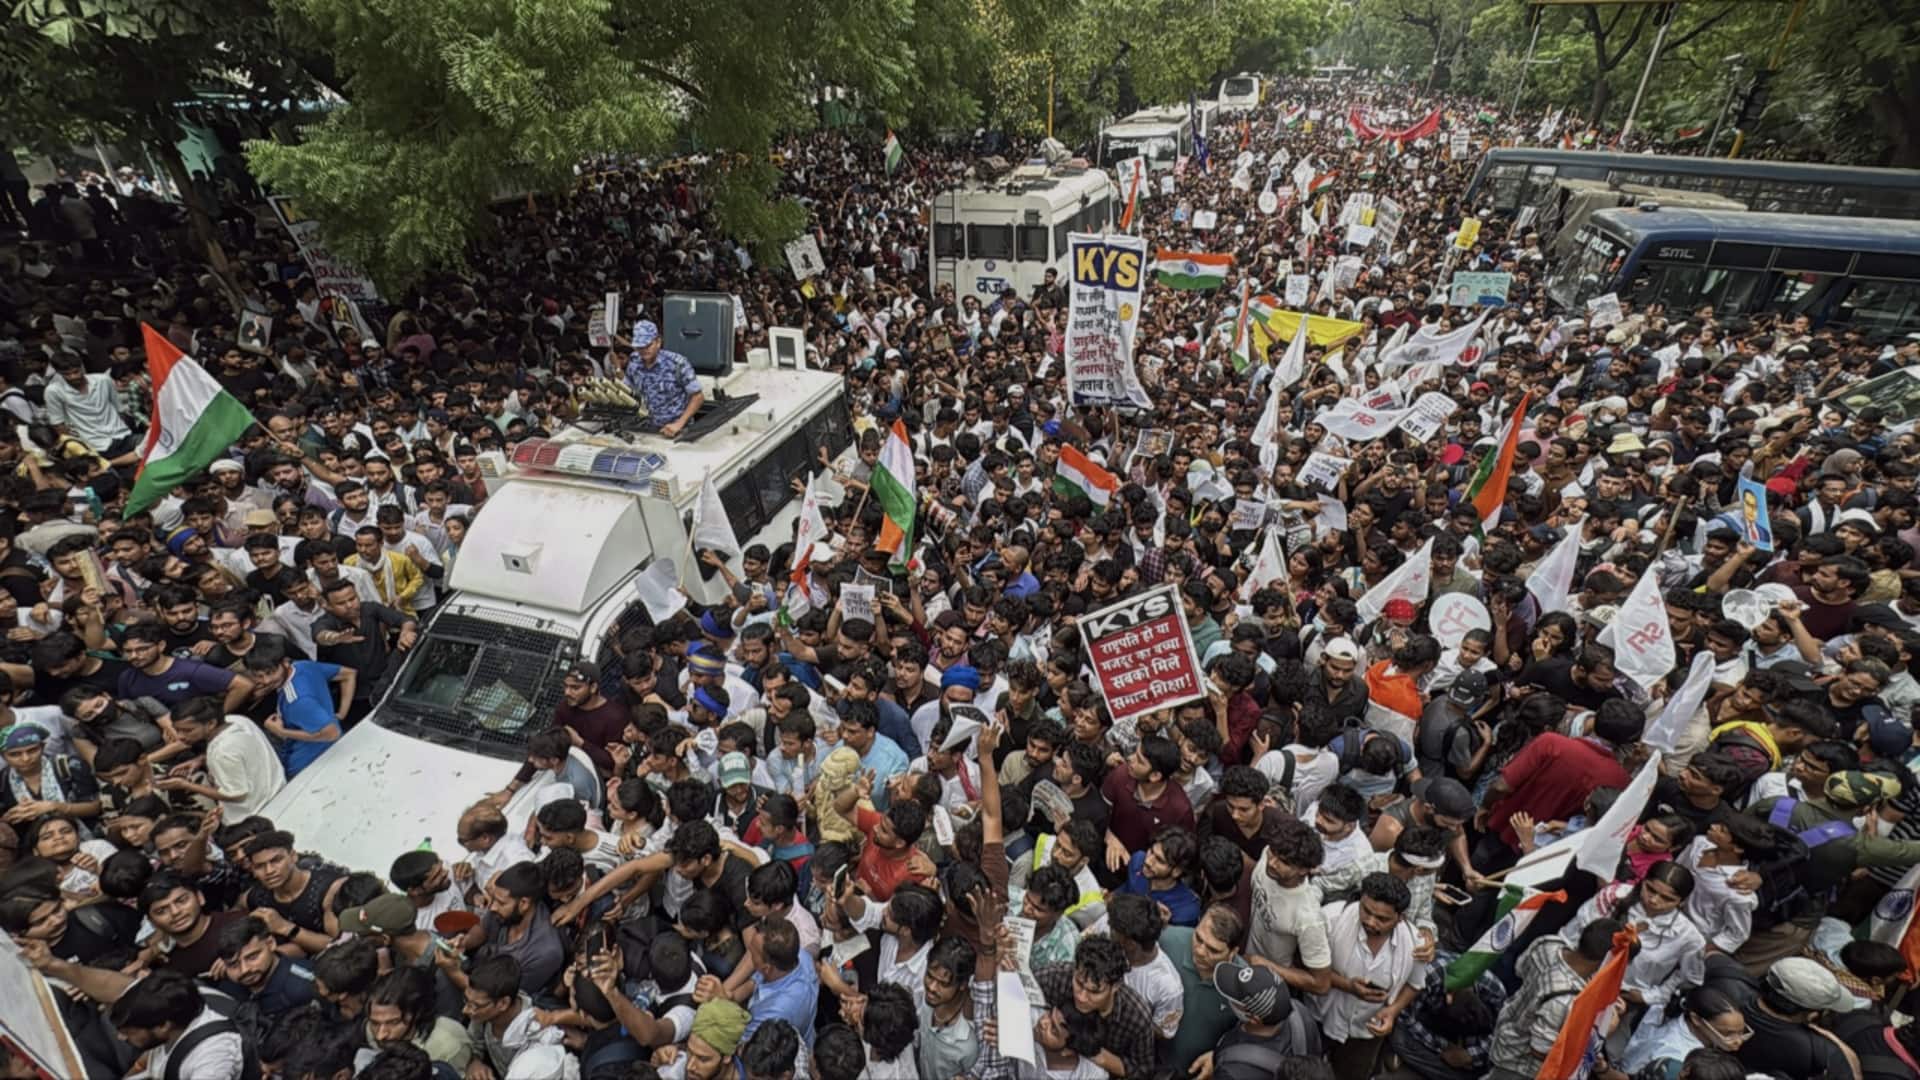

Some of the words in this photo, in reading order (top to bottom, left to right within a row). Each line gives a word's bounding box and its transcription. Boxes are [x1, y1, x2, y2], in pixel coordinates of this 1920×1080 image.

[1658, 247, 1696, 258] SML
[1077, 247, 1139, 288] KYS
[1403, 419, 1427, 438] SFI
[1088, 595, 1170, 640] KYS
[1141, 626, 1154, 641] हो
[1155, 622, 1170, 635] या
[1136, 648, 1151, 661] का
[1110, 665, 1150, 690] सबको
[1152, 654, 1181, 675] मिले
[1110, 690, 1149, 711] समान
